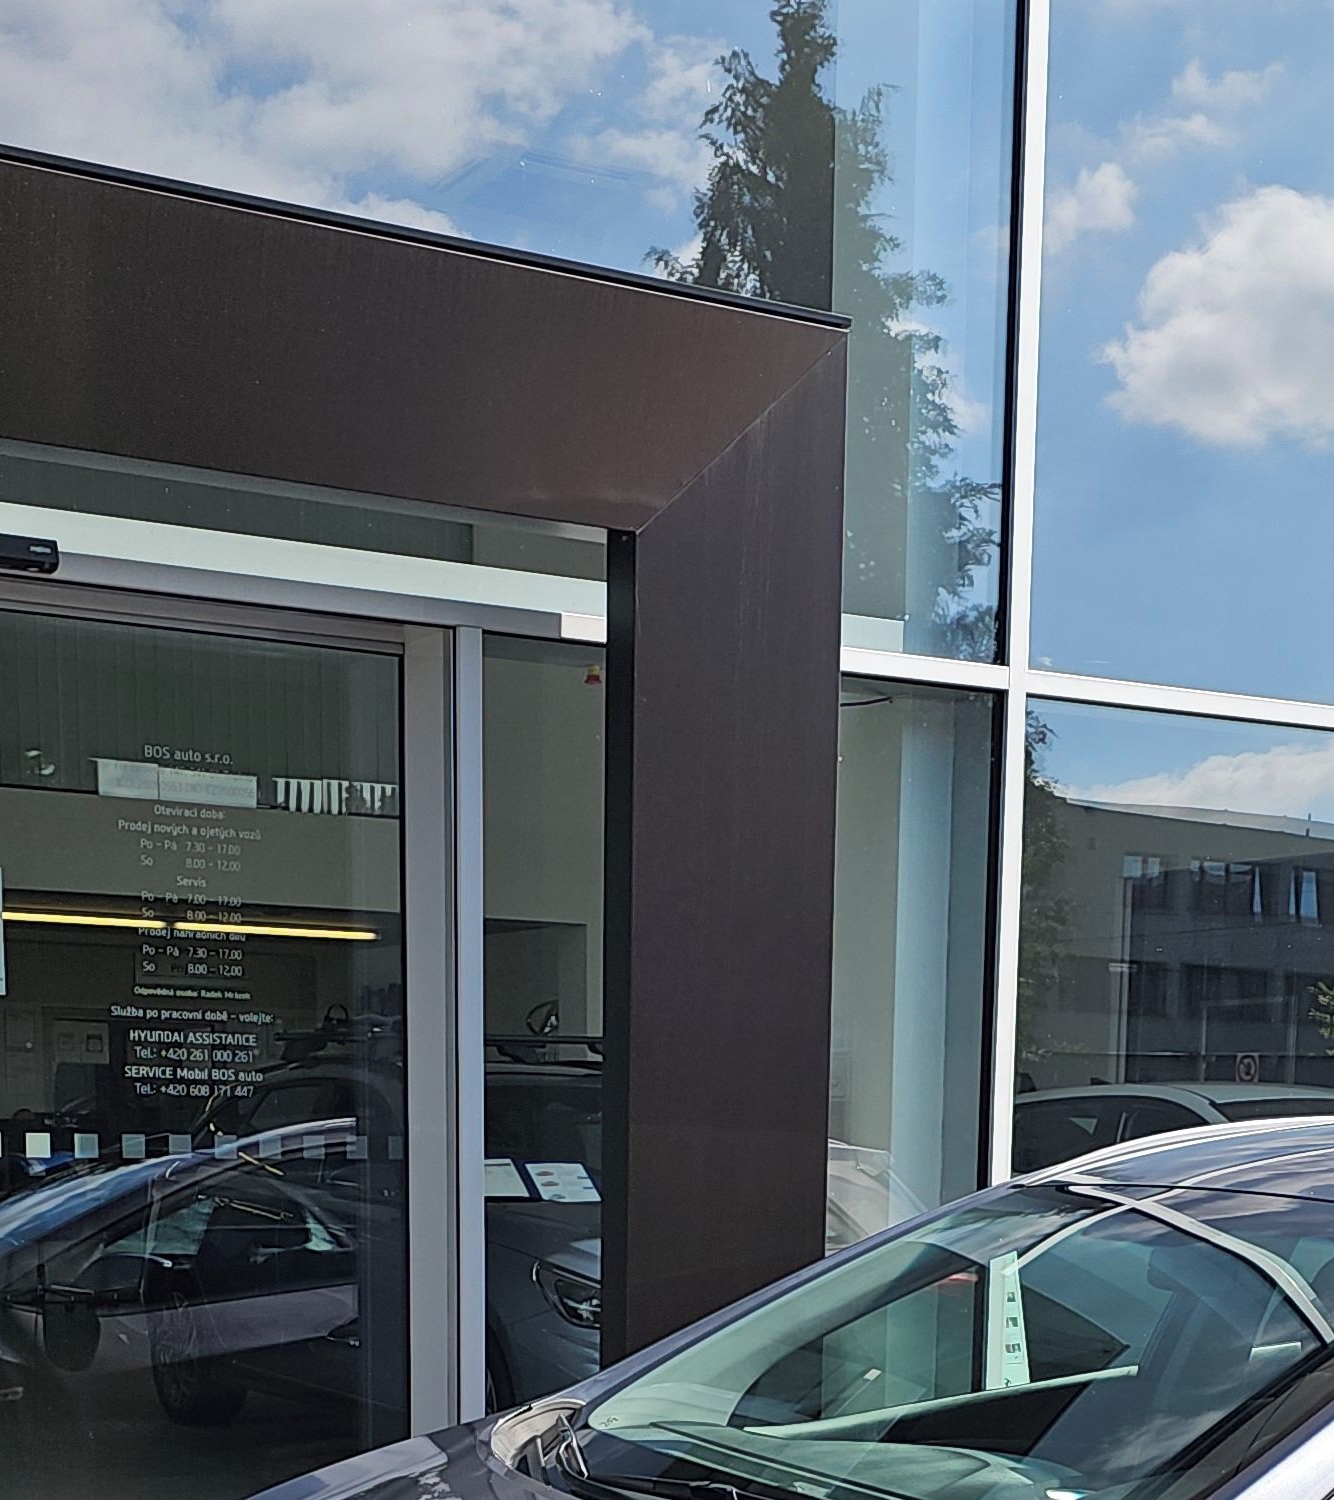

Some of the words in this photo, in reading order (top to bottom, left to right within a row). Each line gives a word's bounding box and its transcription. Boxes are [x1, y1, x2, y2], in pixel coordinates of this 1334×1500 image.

[144, 744, 171, 759] BOS
[174, 749, 202, 762] auto
[204, 752, 234, 765] s.r.o.
[118, 819, 152, 833] Prodej
[153, 823, 189, 837] nových
[191, 827, 198, 836] a
[200, 826, 236, 841] ojetých
[140, 839, 153, 850] Po
[186, 841, 205, 853] 7.30
[216, 843, 242, 856] 17.00
[140, 855, 154, 866] So
[216, 859, 242, 872] 12.00
[176, 874, 207, 888] Servis
[141, 890, 155, 902] Po
[141, 907, 155, 918] So
[138, 925, 171, 940] Prodej
[142, 945, 156, 956] Po
[188, 947, 208, 959] 7.30
[218, 949, 243, 961] 17.00
[142, 961, 156, 973] So
[187, 963, 208, 975] 8.00
[218, 965, 243, 977] 12.00
[110, 1005, 144, 1018] Služba
[146, 1010, 158, 1020] po
[160, 1009, 203, 1021] pracovní
[204, 1010, 228, 1022] době
[129, 1029, 184, 1044] HYUNDAI
[187, 1031, 258, 1047] ASSISTANCE
[160, 1049, 188, 1061] +420
[189, 1050, 209, 1062] 261
[212, 1050, 233, 1062] 000
[234, 1051, 254, 1063] 261
[124, 1065, 173, 1079] SERVICE
[176, 1068, 209, 1080] Mobil
[211, 1068, 236, 1081] BOS
[238, 1070, 264, 1082] auto
[160, 1084, 188, 1096] +420
[189, 1085, 210, 1097] 608
[234, 1085, 255, 1098] 447
